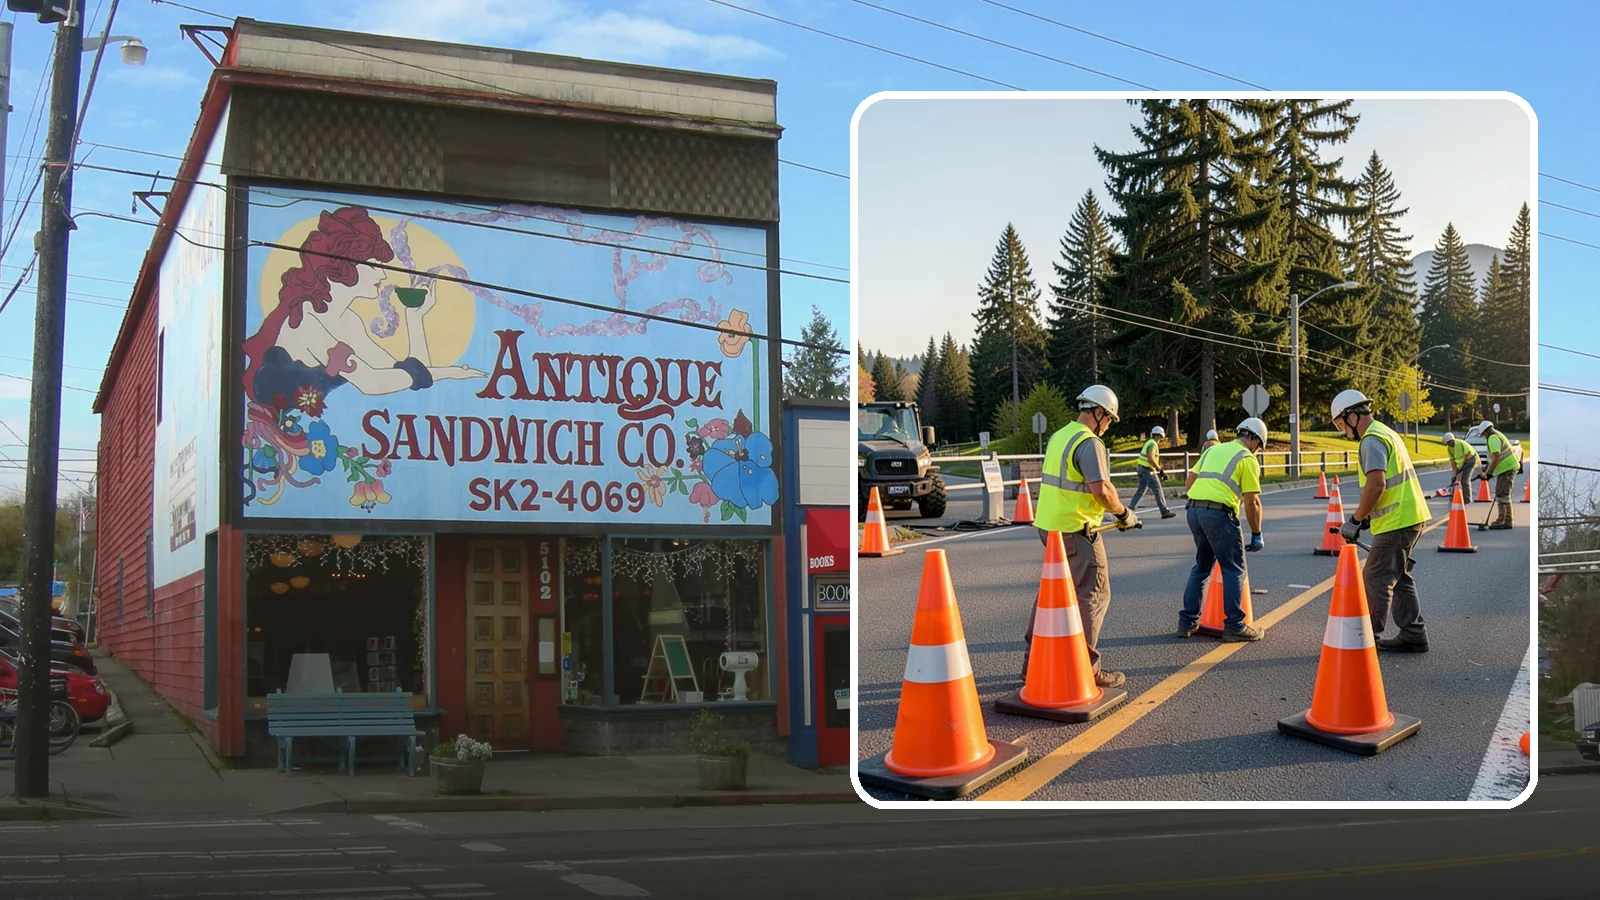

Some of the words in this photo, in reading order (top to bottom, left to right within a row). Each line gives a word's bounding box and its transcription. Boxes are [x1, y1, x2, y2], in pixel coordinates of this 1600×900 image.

[361, 408, 604, 467] SANDWICH
[617, 422, 684, 468] CO.
[468, 478, 645, 512] SK2-4069
[539, 542, 551, 599] 5102
[809, 555, 835, 569] BOOKS
